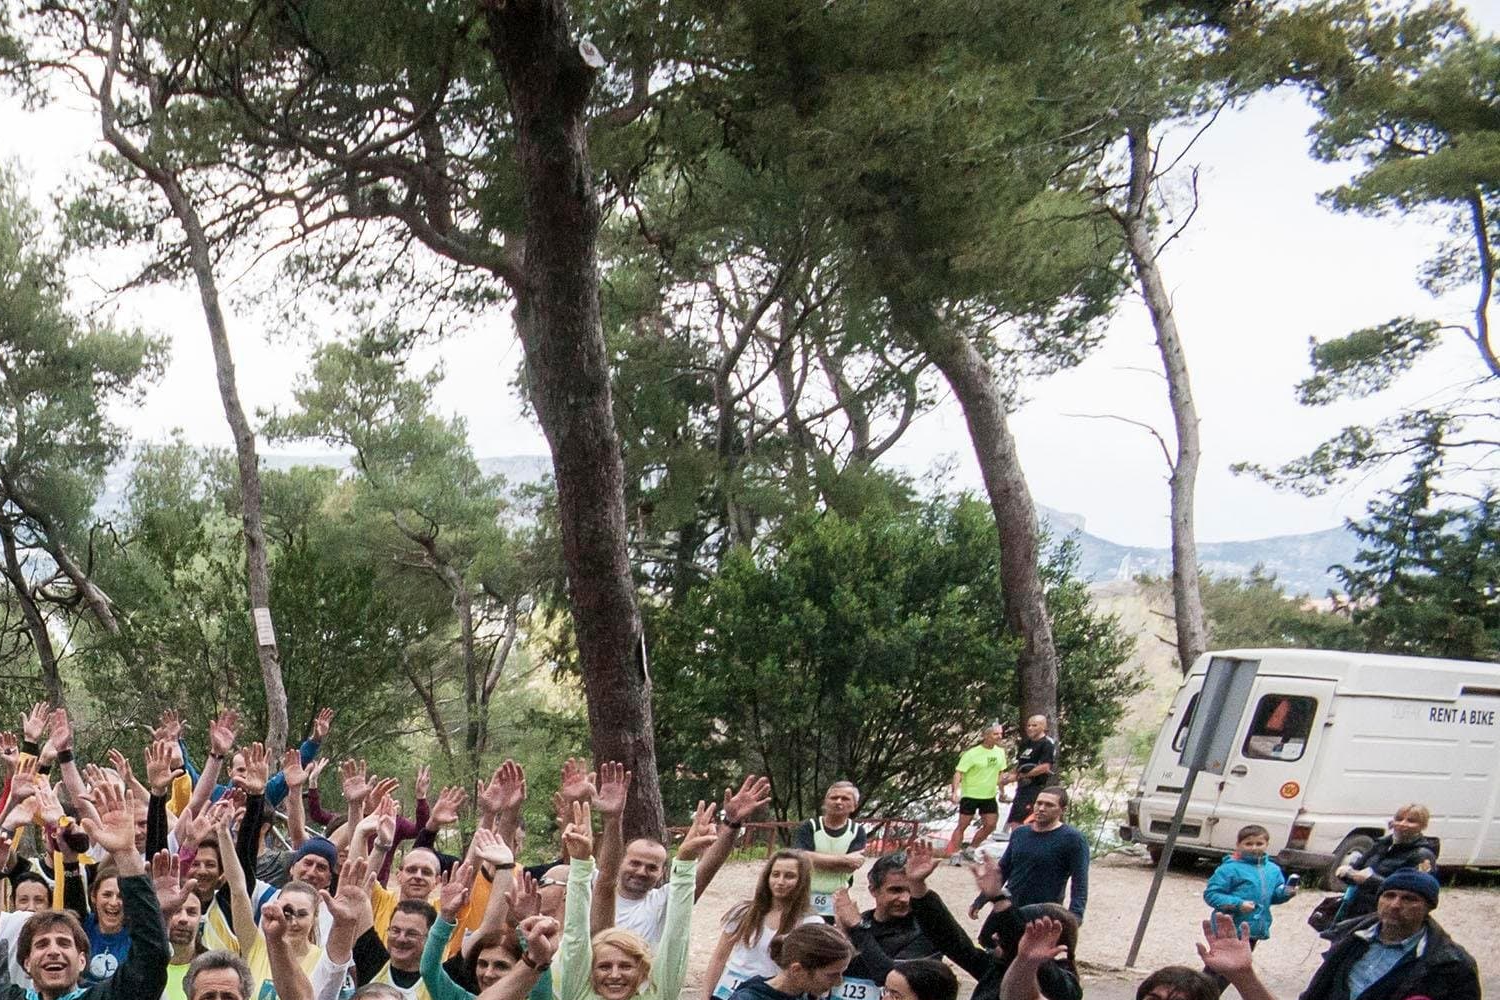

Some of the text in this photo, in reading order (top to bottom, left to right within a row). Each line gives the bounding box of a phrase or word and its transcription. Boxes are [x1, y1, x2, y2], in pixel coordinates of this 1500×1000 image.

[1429, 707, 1458, 723] RENT
[1460, 710, 1467, 724] A
[1469, 710, 1495, 725] BIKE
[815, 896, 827, 905] 66
[842, 984, 867, 1000] 123
